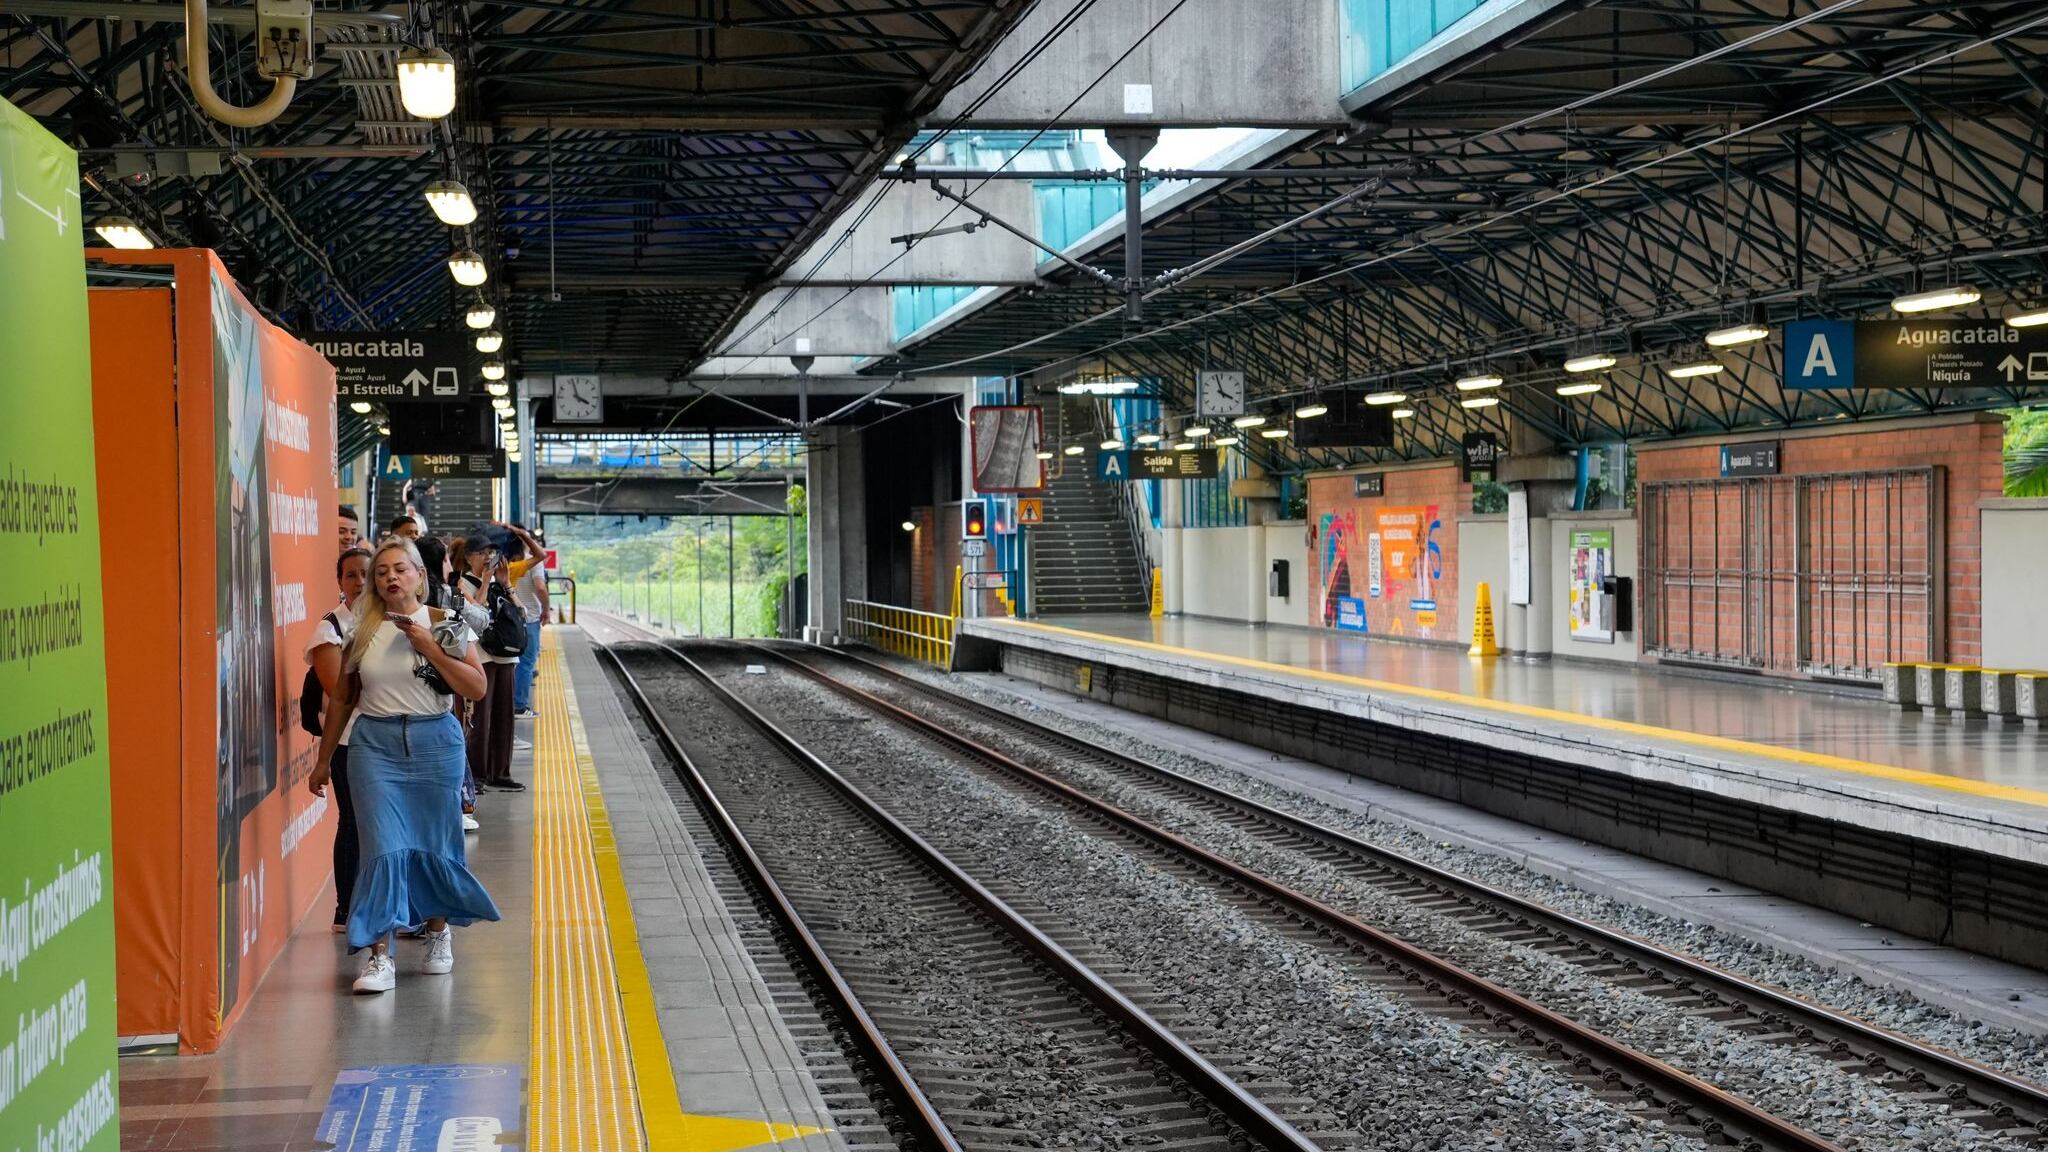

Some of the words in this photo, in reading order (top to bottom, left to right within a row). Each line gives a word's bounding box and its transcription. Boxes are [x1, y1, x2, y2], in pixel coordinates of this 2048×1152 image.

[1896, 325, 2020, 349] Aguacatala
[301, 338, 425, 358] guacatala
[1801, 333, 1837, 377] A
[1932, 369, 1971, 384] Niquía
[353, 384, 404, 395] Estrella
[386, 454, 404, 474] A
[423, 454, 461, 465] Salida
[433, 465, 450, 474] Exit
[1105, 455, 1121, 476] A
[1143, 456, 1173, 466] Salida
[1151, 466, 1165, 474] Exit
[22, 468, 65, 547] trayecto
[67, 485, 78, 534] es
[19, 583, 82, 673] oportunidad
[27, 707, 96, 783] encontramos.
[0, 877, 30, 983] Aquí
[31, 848, 102, 952] construimos
[18, 1009, 58, 1093] futuro
[60, 977, 87, 1067] para
